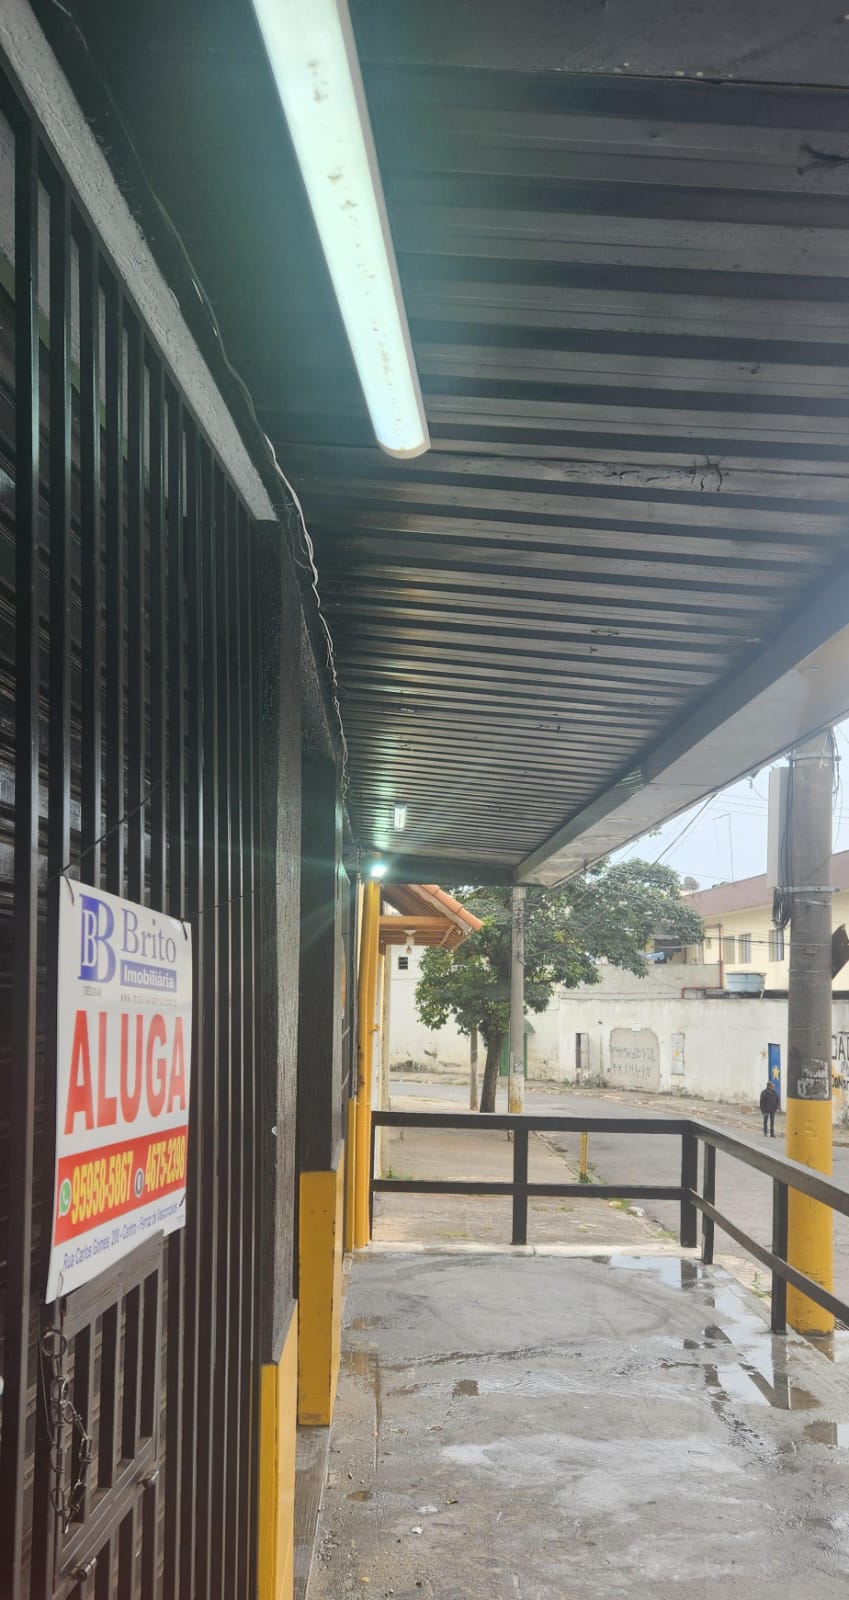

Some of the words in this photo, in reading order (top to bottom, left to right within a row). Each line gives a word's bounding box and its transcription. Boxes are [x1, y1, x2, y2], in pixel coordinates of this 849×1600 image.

[121, 909, 176, 963] Brito
[124, 966, 174, 988] Imobiliária
[63, 1010, 186, 1135] ALUGA
[72, 1152, 133, 1223] 95958-5867
[63, 1252, 74, 1270] Rua
[75, 1246, 92, 1265] Carlos
[122, 1223, 137, 1240] Centro
